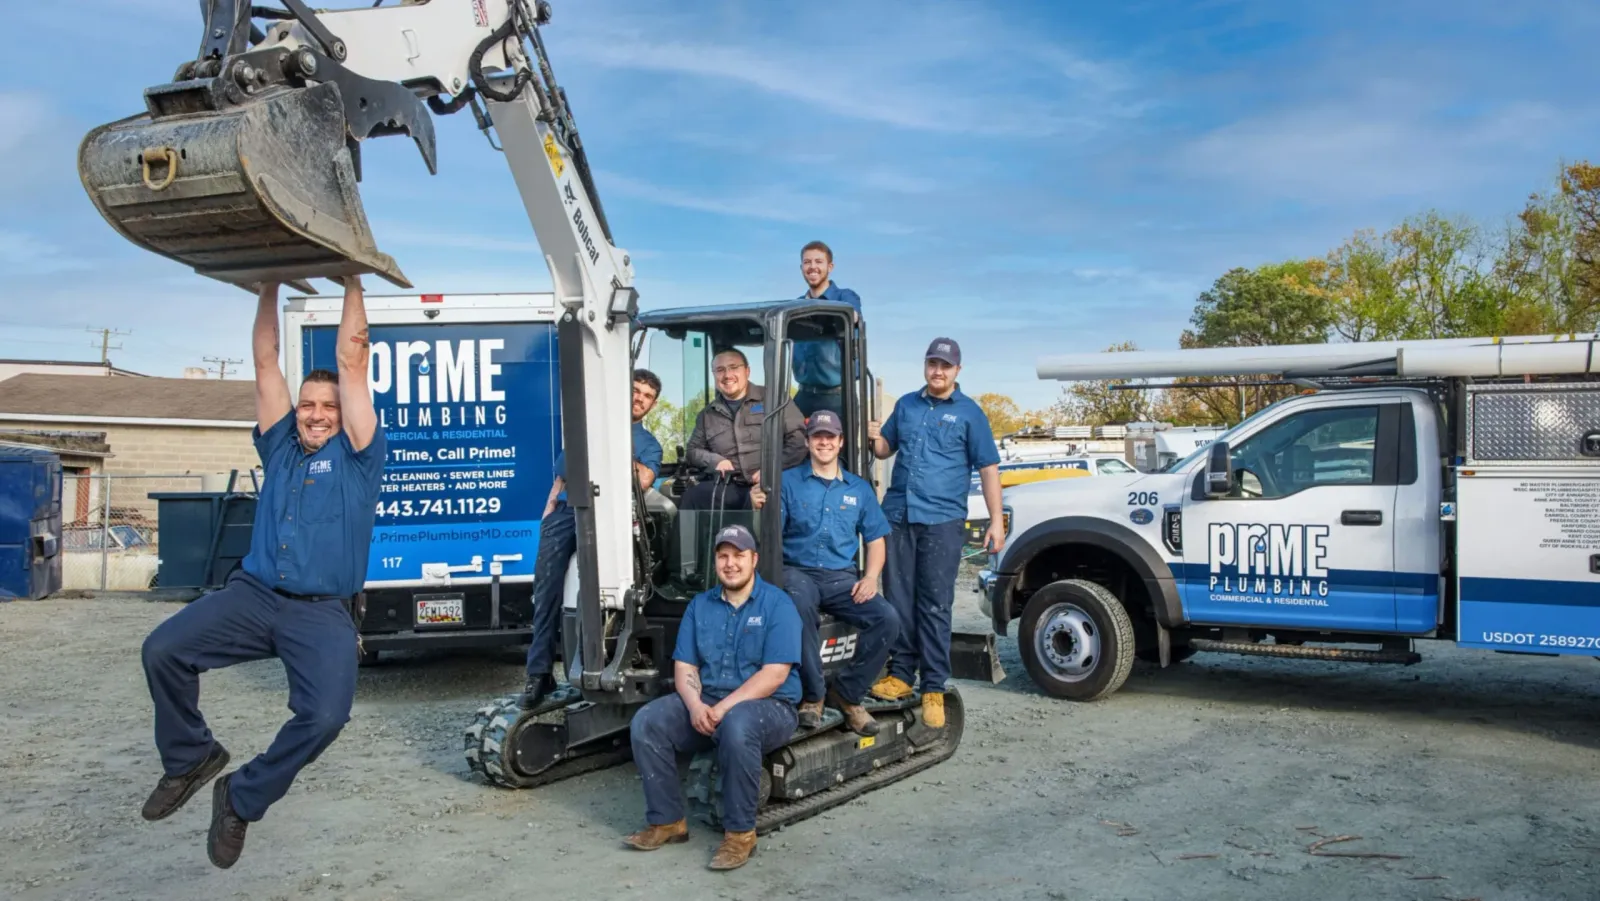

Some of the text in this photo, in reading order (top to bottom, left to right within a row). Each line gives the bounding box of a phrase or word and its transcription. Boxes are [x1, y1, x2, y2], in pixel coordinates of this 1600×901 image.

[573, 207, 600, 266] Bobcat
[380, 405, 507, 427] LUMBING
[385, 429, 508, 441] MERCIAL & RESIDENTIAL
[392, 449, 433, 462] Time,
[437, 447, 465, 460] Call
[469, 446, 516, 459] Prime!
[390, 472, 441, 482] CLEANING
[450, 471, 485, 480] SEWER
[487, 470, 515, 478] LINES
[381, 480, 507, 493] TER HEATERS AND MORE
[1127, 491, 1158, 506] 206
[375, 497, 501, 517] 443.741.1129
[371, 528, 533, 544] .PrimePlumbingMD.com
[382, 556, 403, 569] 117
[1209, 576, 1329, 596] PLUMBING
[1210, 594, 1264, 604] COMMERCIAL
[1274, 597, 1329, 607] RESIDENTIAL
[1483, 632, 1535, 644] USDOT
